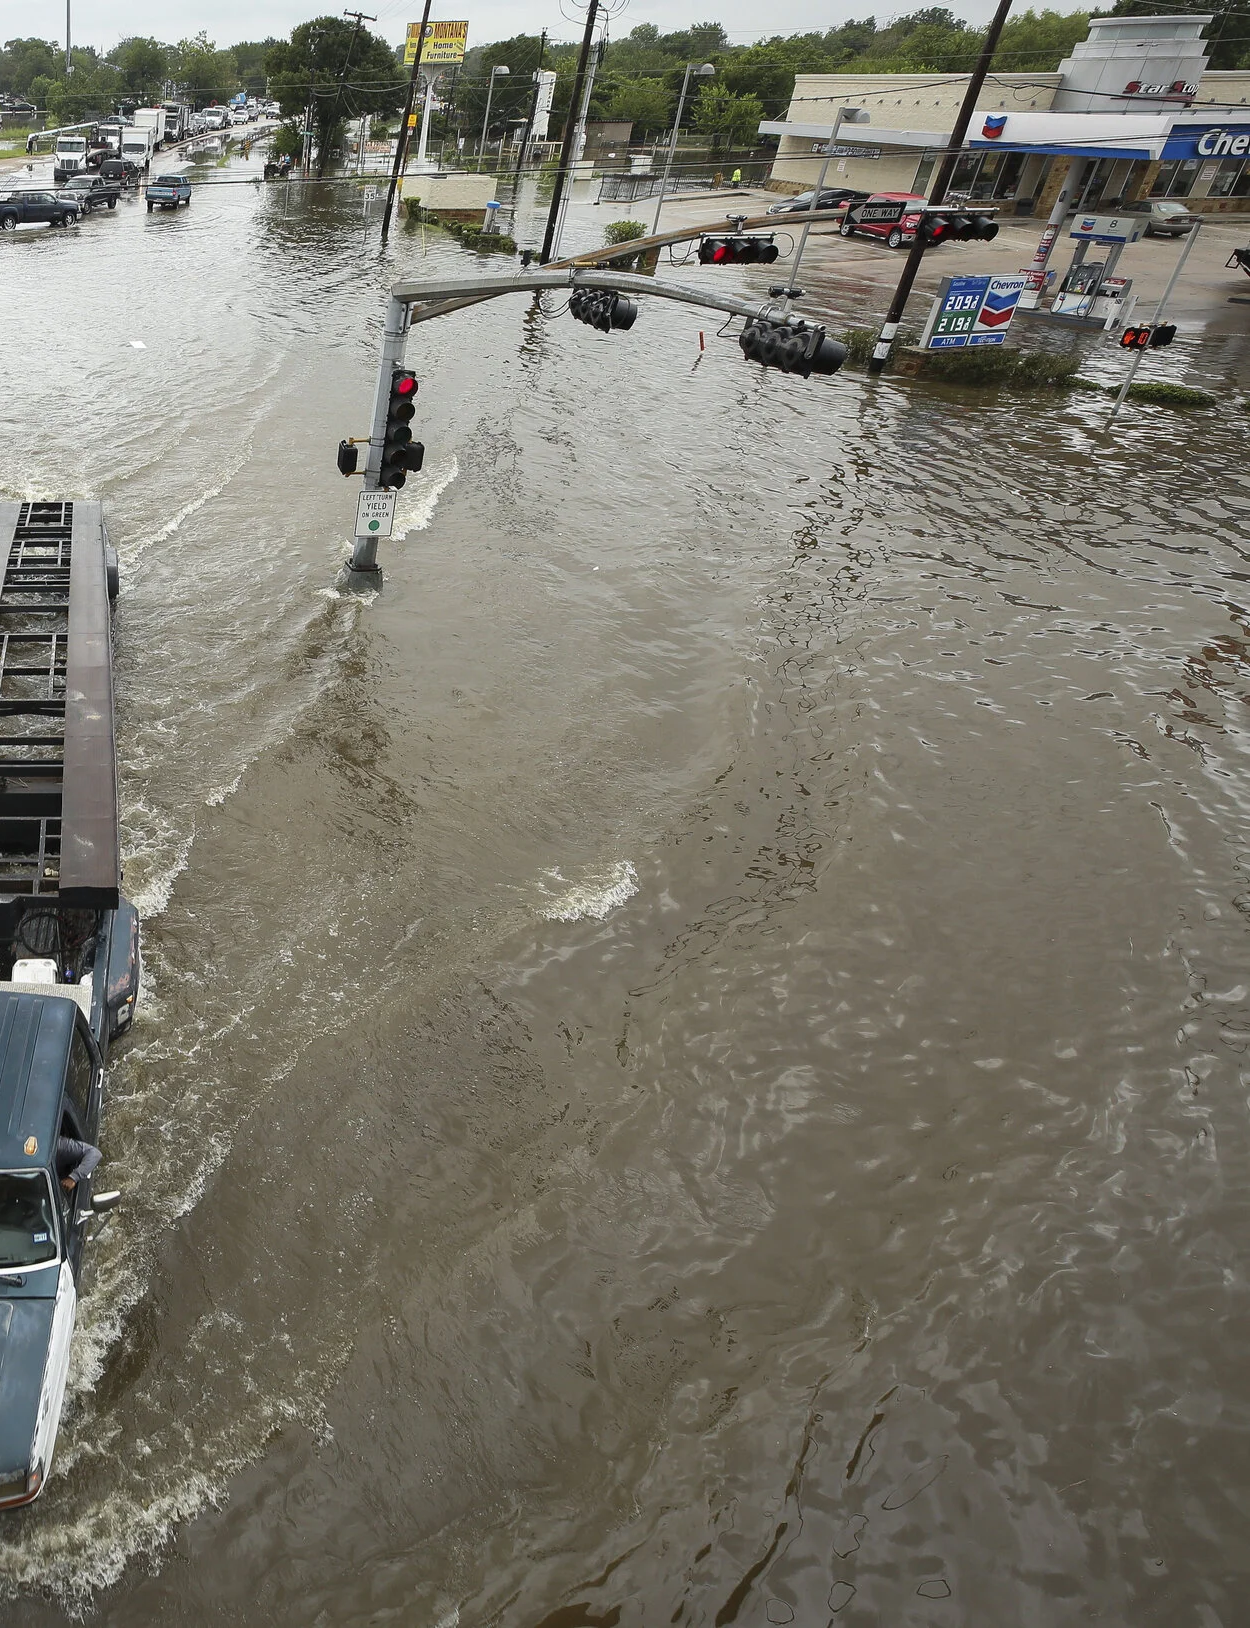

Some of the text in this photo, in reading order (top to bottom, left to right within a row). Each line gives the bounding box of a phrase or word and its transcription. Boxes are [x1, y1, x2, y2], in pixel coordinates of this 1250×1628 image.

[433, 41, 454, 49] Home
[427, 51, 458, 60] Furniture
[1122, 80, 1200, 96] Star Stop
[1197, 128, 1250, 156] Che
[364, 192, 376, 200] 35
[861, 208, 899, 218] ONE WAY
[1110, 219, 1119, 229] 8
[991, 280, 1025, 290] Chevron
[941, 338, 956, 346] ATM
[367, 502, 387, 510] YIELD
